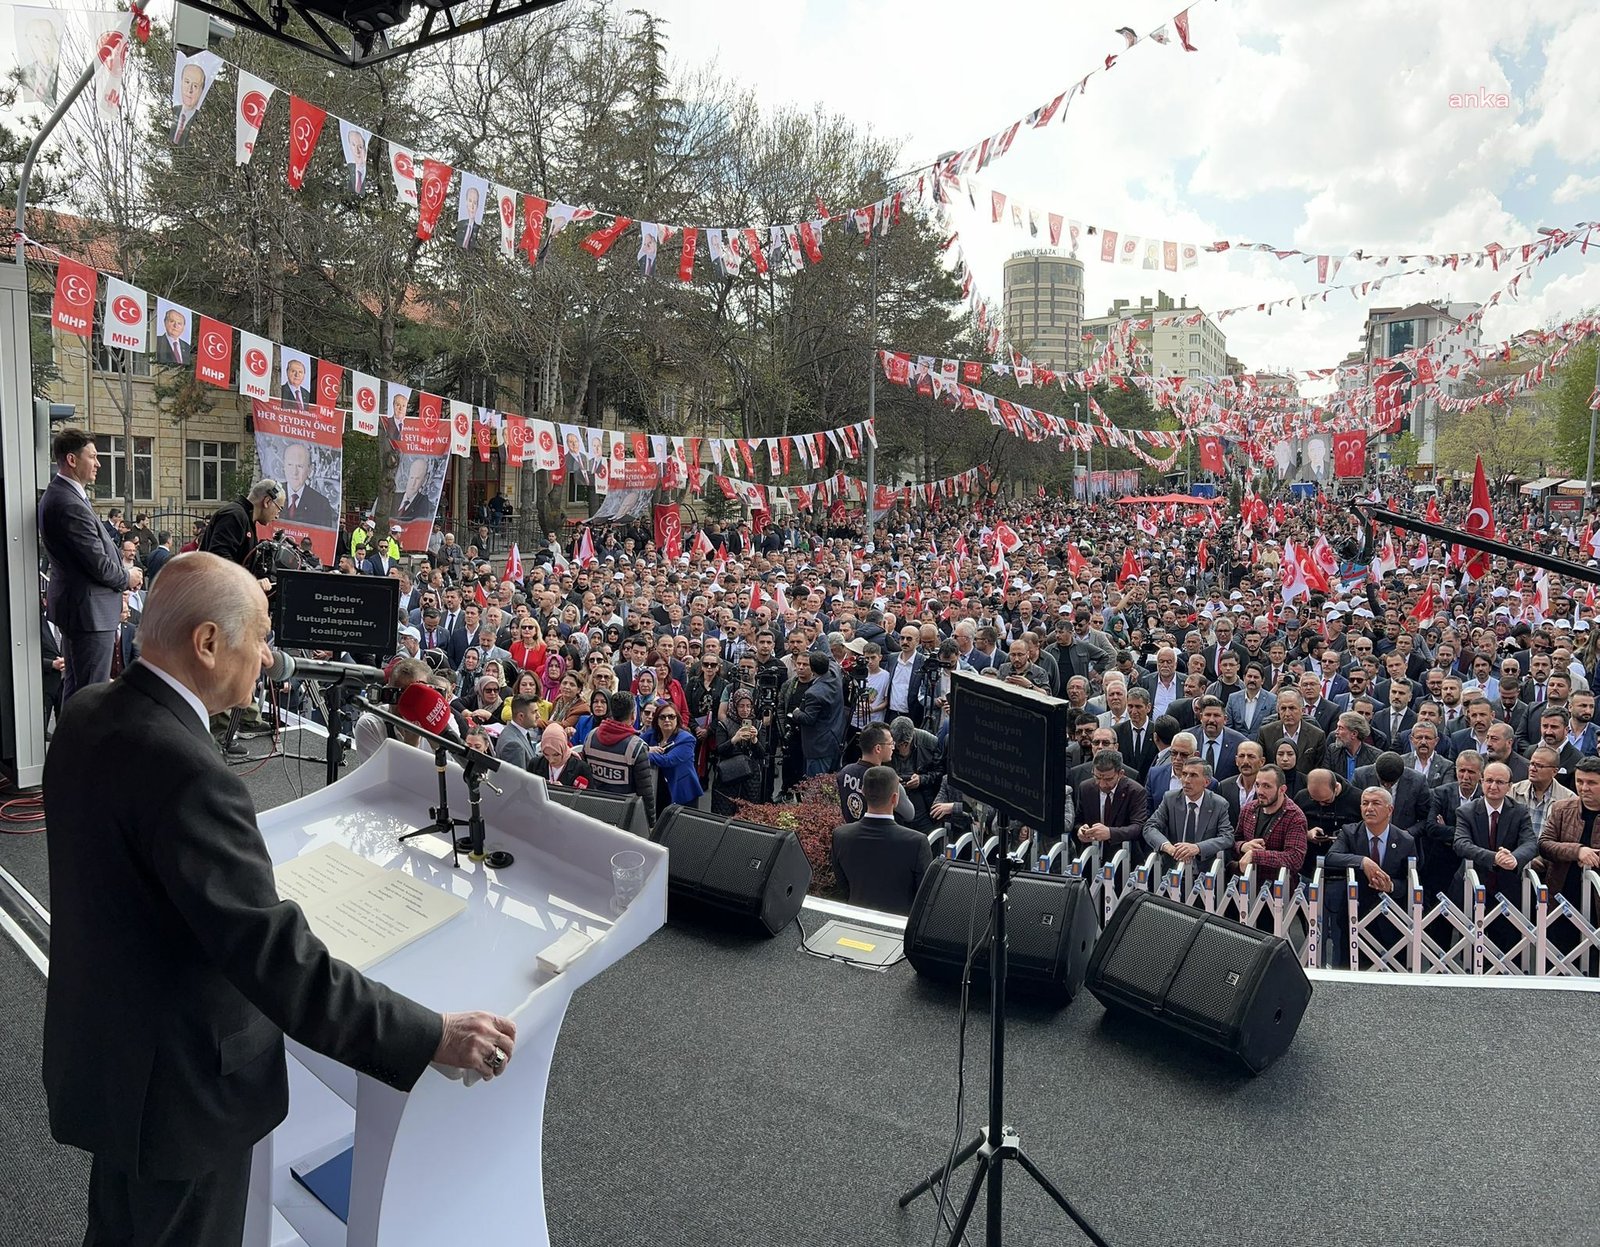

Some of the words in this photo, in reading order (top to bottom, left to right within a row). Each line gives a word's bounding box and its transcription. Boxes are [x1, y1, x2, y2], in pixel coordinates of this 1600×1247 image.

[58, 312, 87, 328] MHP
[112, 333, 139, 346] MHP
[202, 366, 225, 380] MHP
[247, 384, 265, 396] MHP
[257, 410, 276, 421] HER
[313, 420, 337, 434] ÖNCE
[359, 421, 374, 431] MHP
[280, 424, 316, 439] TÜRKİYE
[315, 593, 364, 605] Darbeler,
[323, 606, 355, 614] siyasi
[296, 615, 377, 628] kutuplaşmalar,
[310, 627, 362, 637] koalisyon
